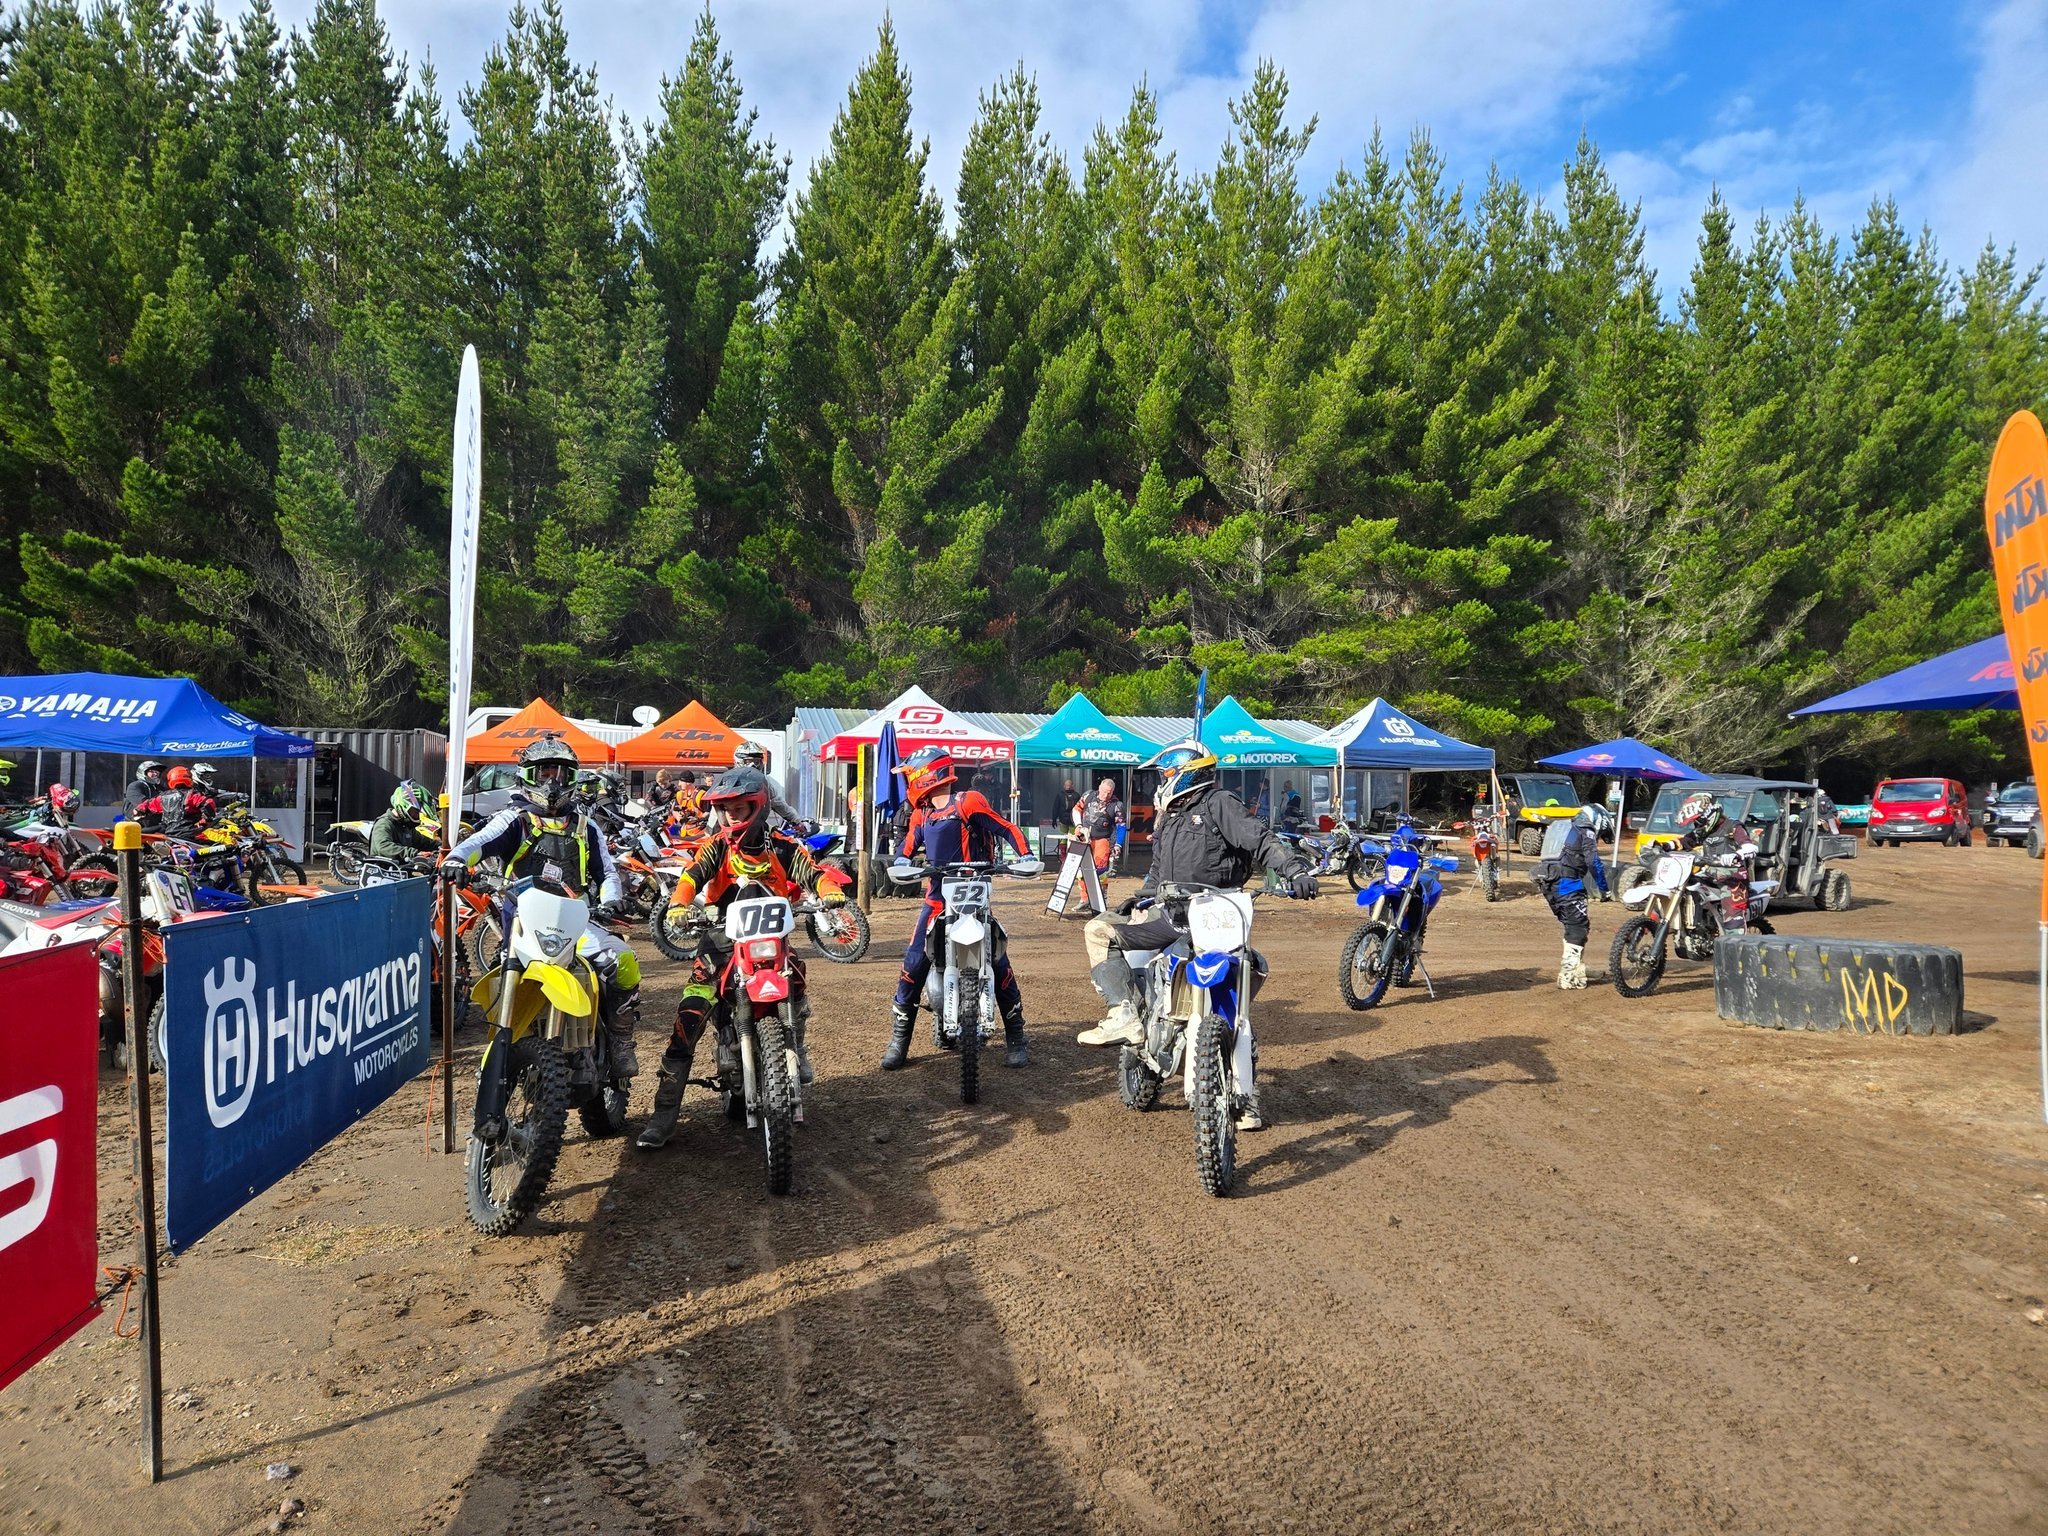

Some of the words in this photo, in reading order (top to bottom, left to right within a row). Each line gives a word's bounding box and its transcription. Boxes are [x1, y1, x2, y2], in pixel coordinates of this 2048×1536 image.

[20, 692, 158, 718] YAMAHA
[496, 727, 567, 738] KTM
[659, 729, 724, 741] KTM
[896, 728, 968, 736] ASGAS
[161, 741, 195, 752] Revs
[196, 742, 221, 752] Your
[220, 740, 248, 749] Heart
[676, 748, 709, 758] KTM
[1080, 749, 1141, 762] MOTOREX
[1240, 753, 1298, 764] MOTOREX
[952, 885, 984, 902] 52
[1, 902, 40, 918] HONDA
[736, 903, 787, 939] 08
[1841, 967, 1908, 1034] MD
[266, 952, 421, 1085] Husqvarna
[353, 1025, 419, 1086] MOTORCYCLES
